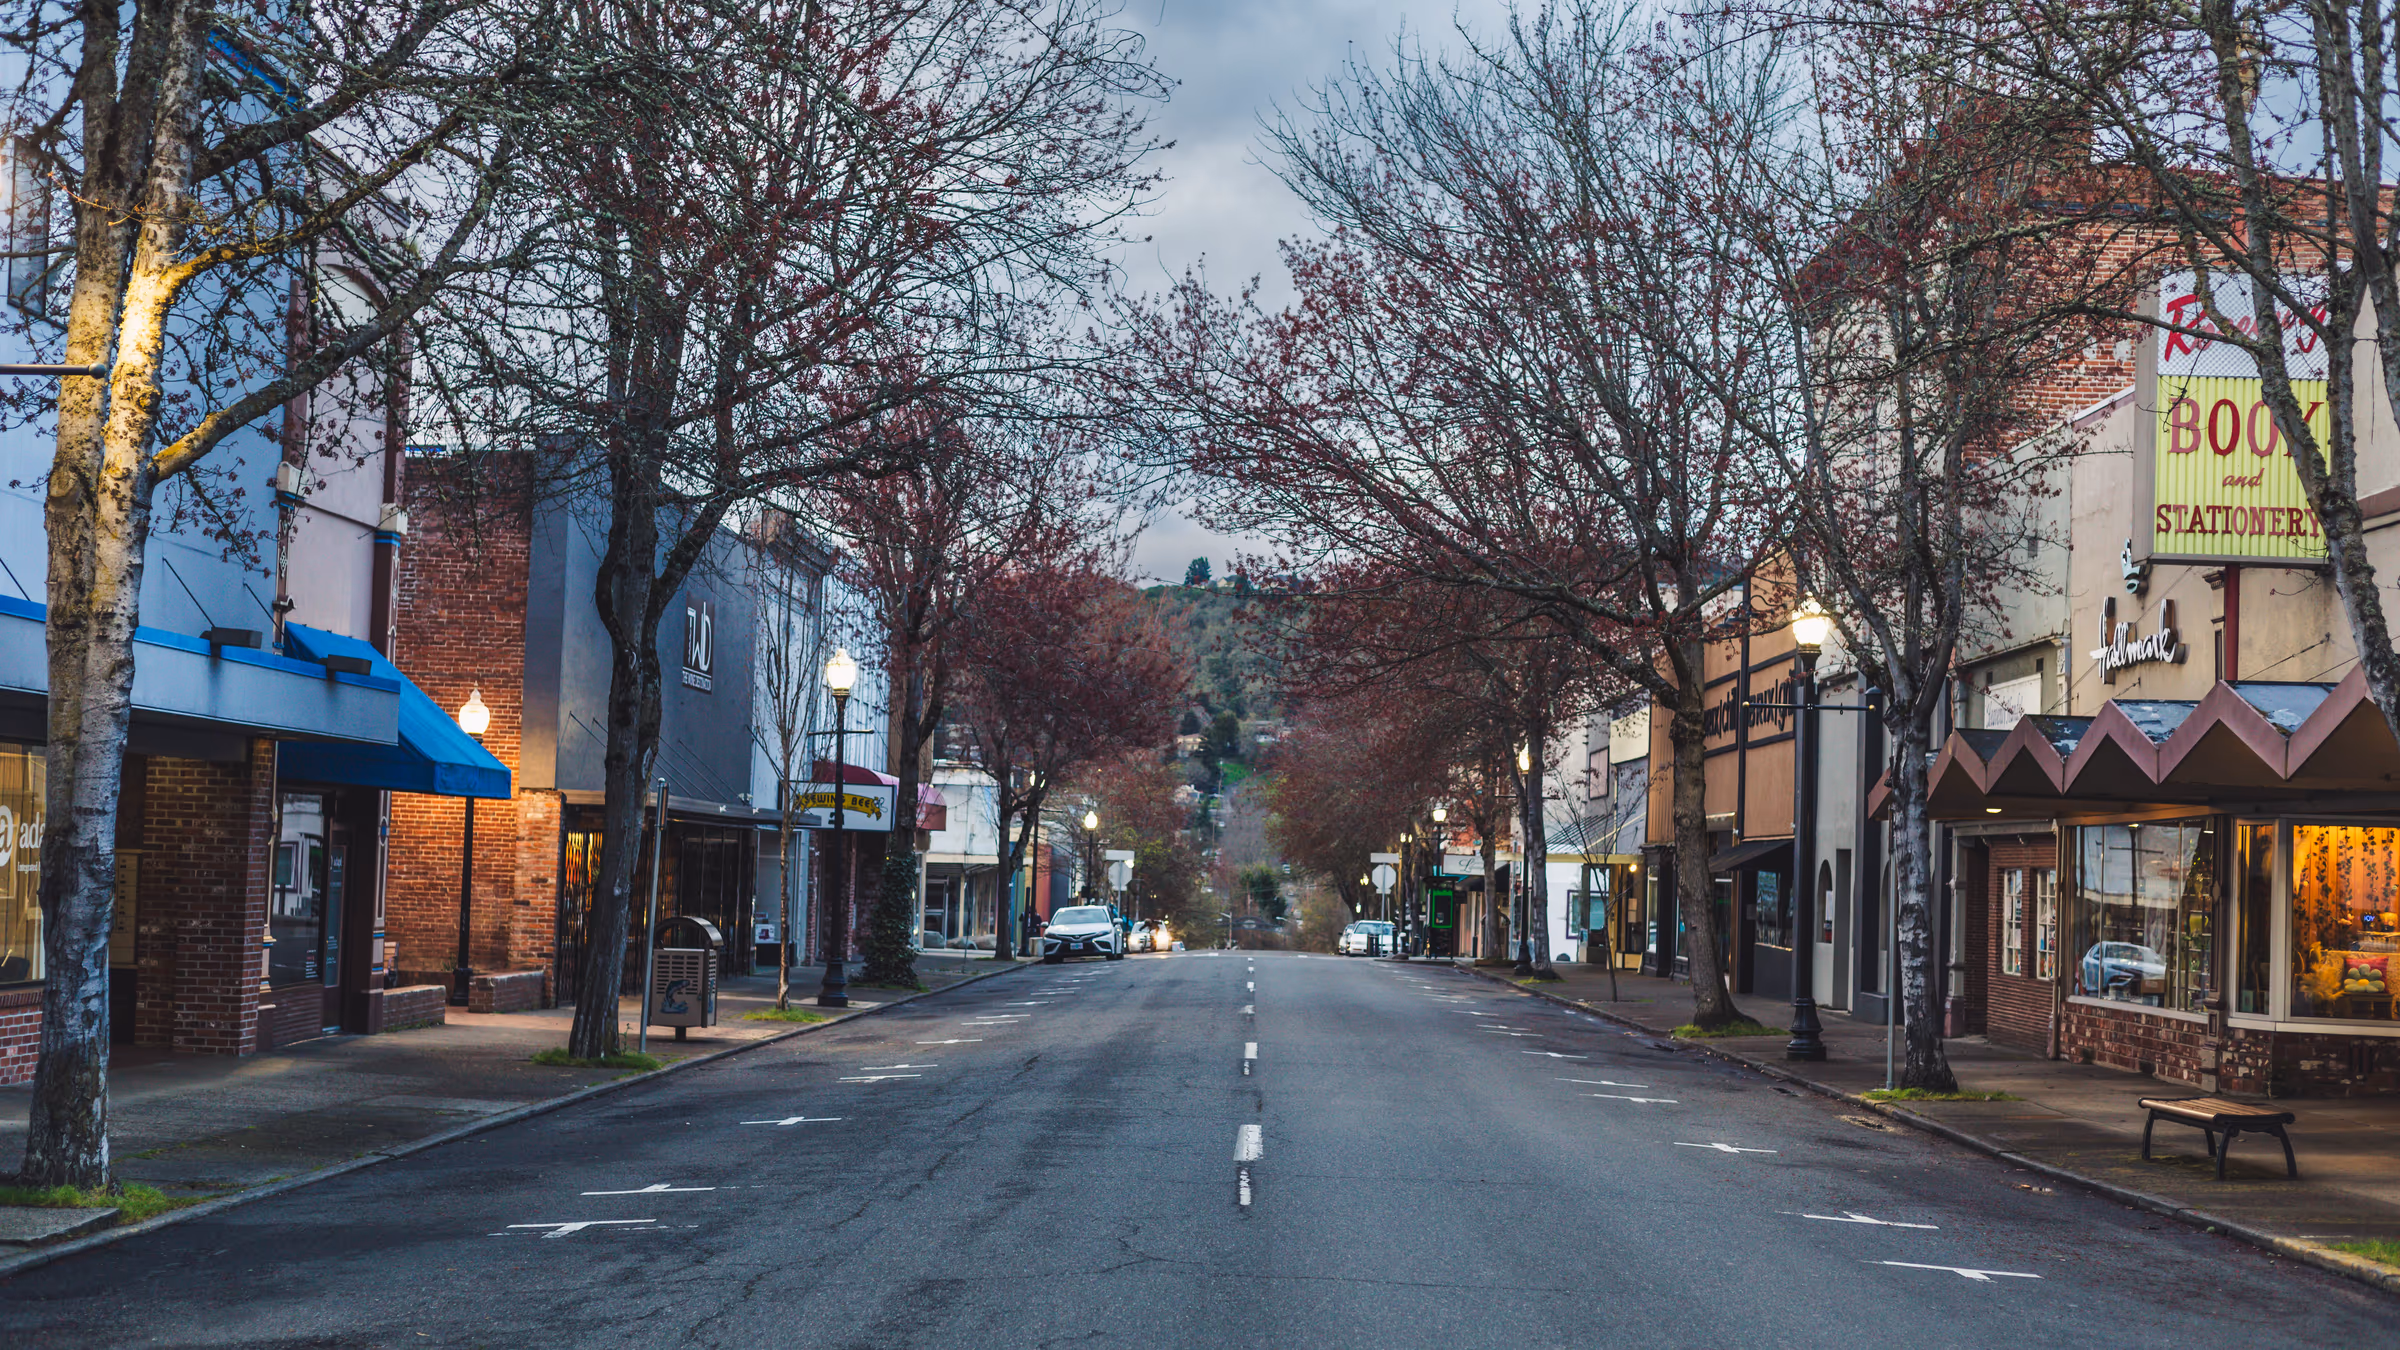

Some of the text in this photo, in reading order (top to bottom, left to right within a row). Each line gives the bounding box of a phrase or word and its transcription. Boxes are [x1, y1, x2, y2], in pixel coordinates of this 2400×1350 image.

[2222, 467, 2265, 487] and
[2156, 503, 2323, 537] STATIONERY
[2089, 596, 2177, 684] Hallmark
[851, 796, 872, 810] BEE
